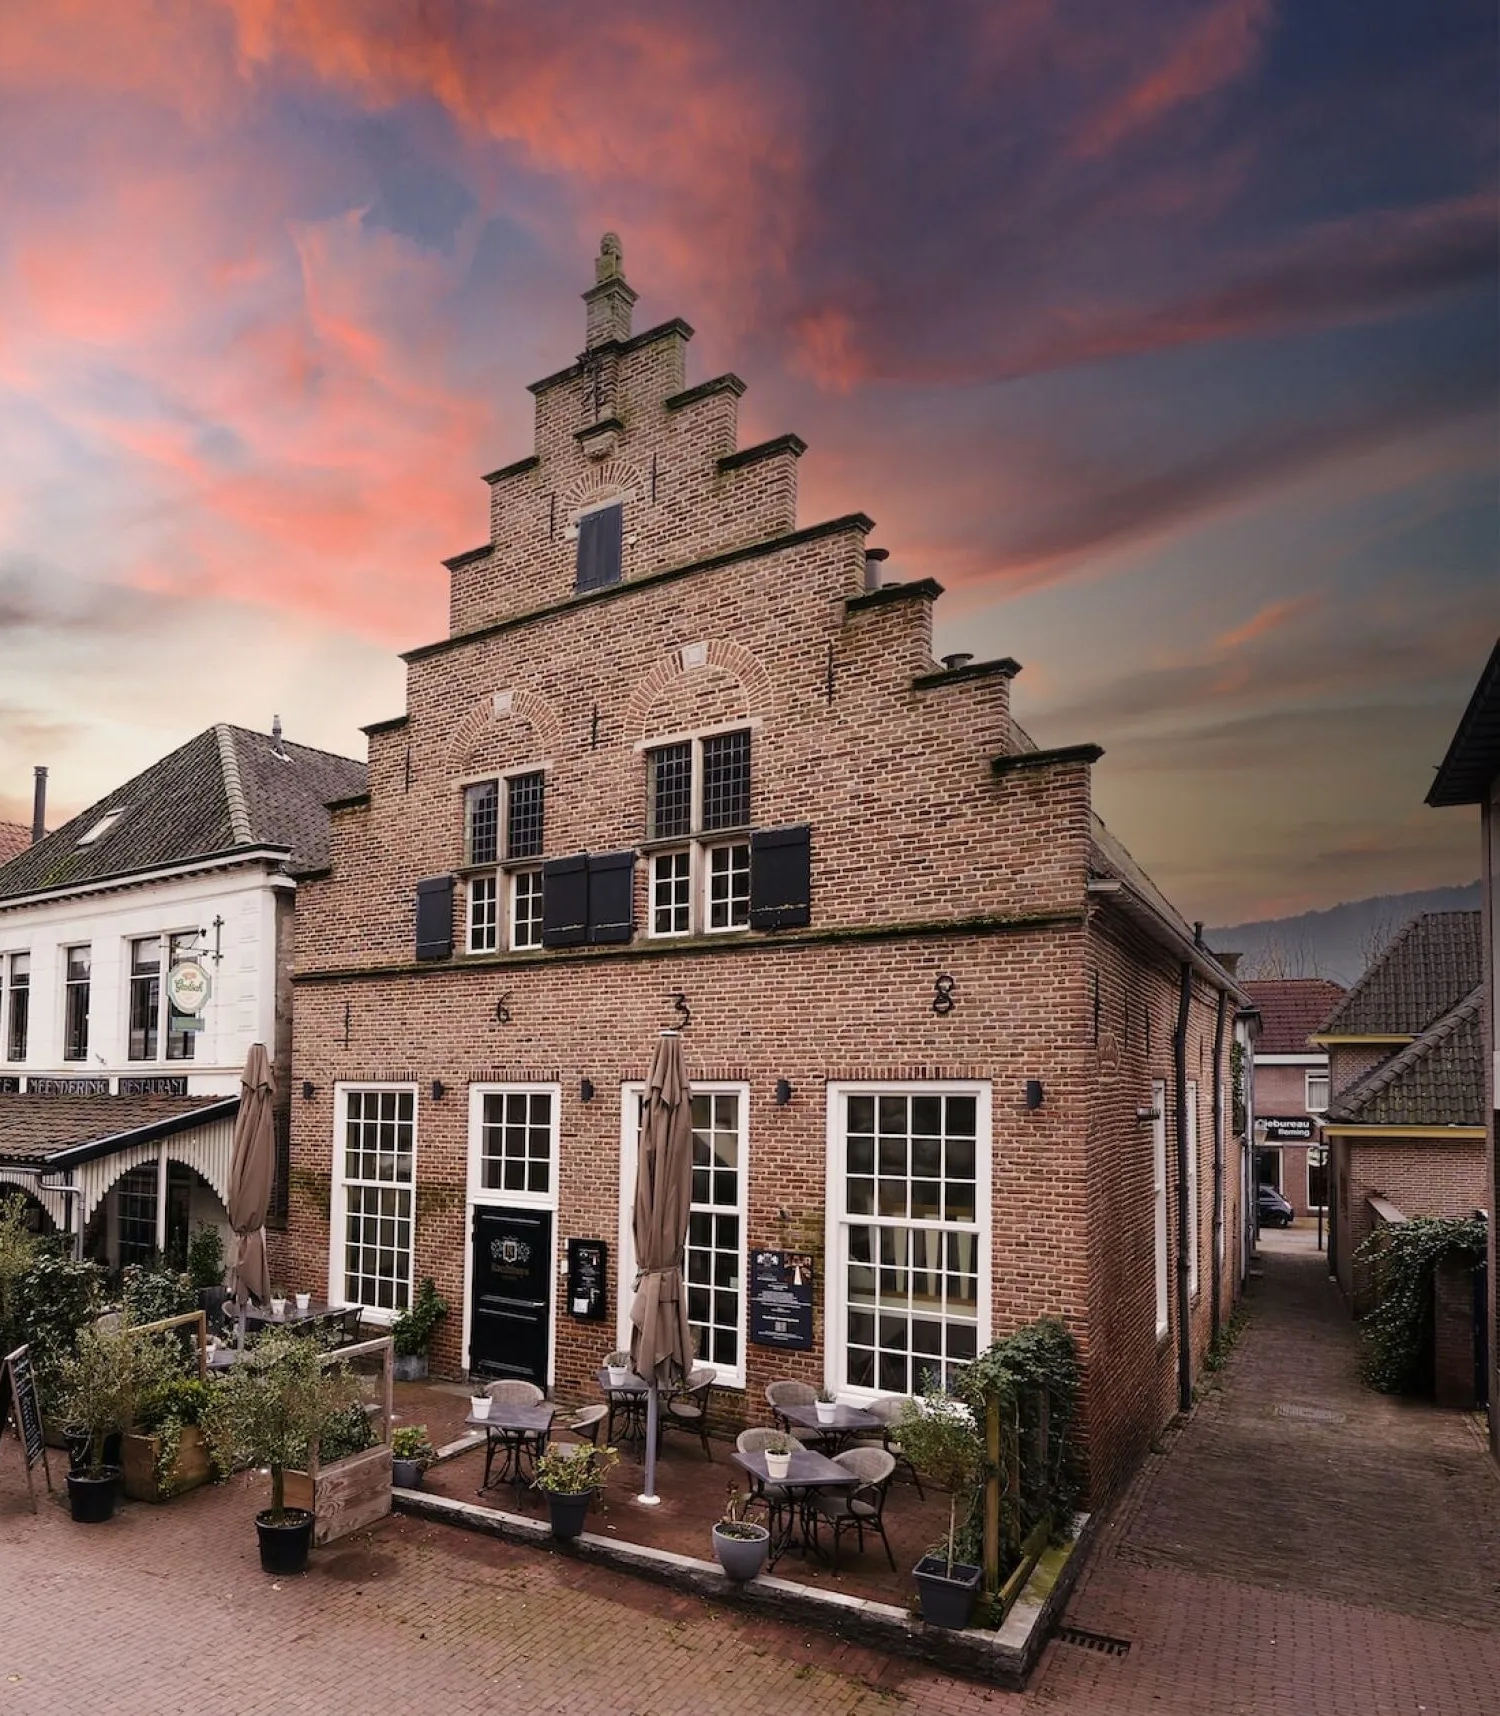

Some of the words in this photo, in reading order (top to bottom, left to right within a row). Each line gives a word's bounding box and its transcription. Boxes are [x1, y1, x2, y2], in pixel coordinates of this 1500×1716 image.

[497, 990, 514, 1023] 6
[658, 993, 690, 1031] 3
[933, 975, 954, 1013] 8
[29, 1078, 108, 1096] MEENDERINK
[121, 1078, 185, 1096] RESTAURANT
